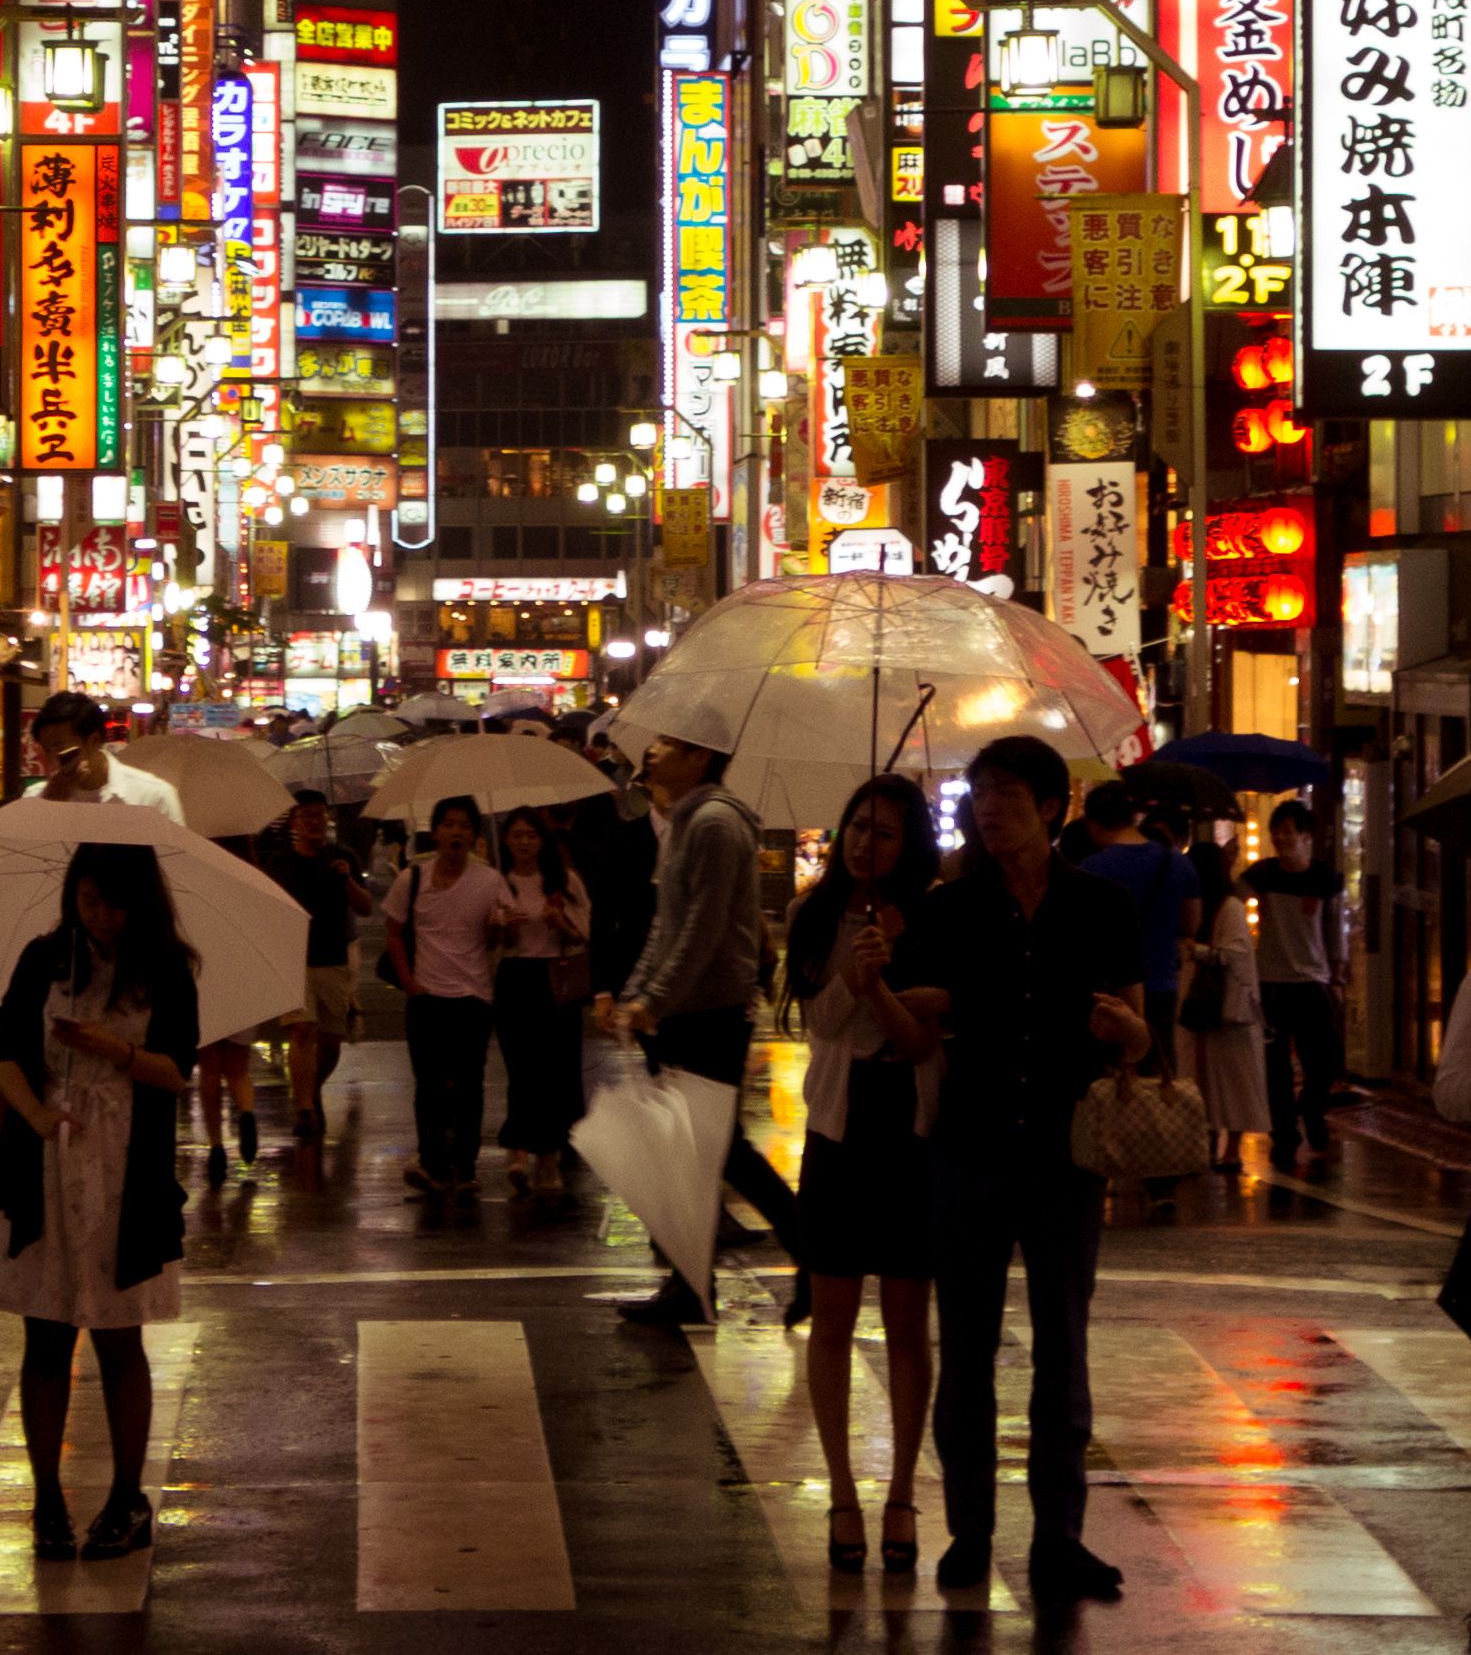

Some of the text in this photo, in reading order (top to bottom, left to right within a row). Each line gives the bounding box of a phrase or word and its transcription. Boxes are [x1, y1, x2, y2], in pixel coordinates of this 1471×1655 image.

[296, 18, 393, 52] 全店営業中
[445, 110, 592, 131] コミック&ネットカフェ
[299, 131, 393, 152] FACE
[678, 80, 726, 320] まんが喫茶
[1081, 212, 1175, 242] 悪質な
[1081, 247, 1176, 277] 客引き
[1081, 283, 1178, 313] に注意
[1213, 266, 1291, 304] 2F
[850, 369, 913, 389] 悪質な
[1360, 354, 1436, 397] 2F
[851, 393, 913, 411] 客引き
[853, 416, 914, 435] に注意
[300, 464, 387, 487] メンズサウナ
[822, 487, 867, 510] 新宿
[1057, 479, 1074, 543] HIROSHIMA
[1080, 477, 1135, 637] お好み焼き
[450, 652, 561, 671] 無料案内所
